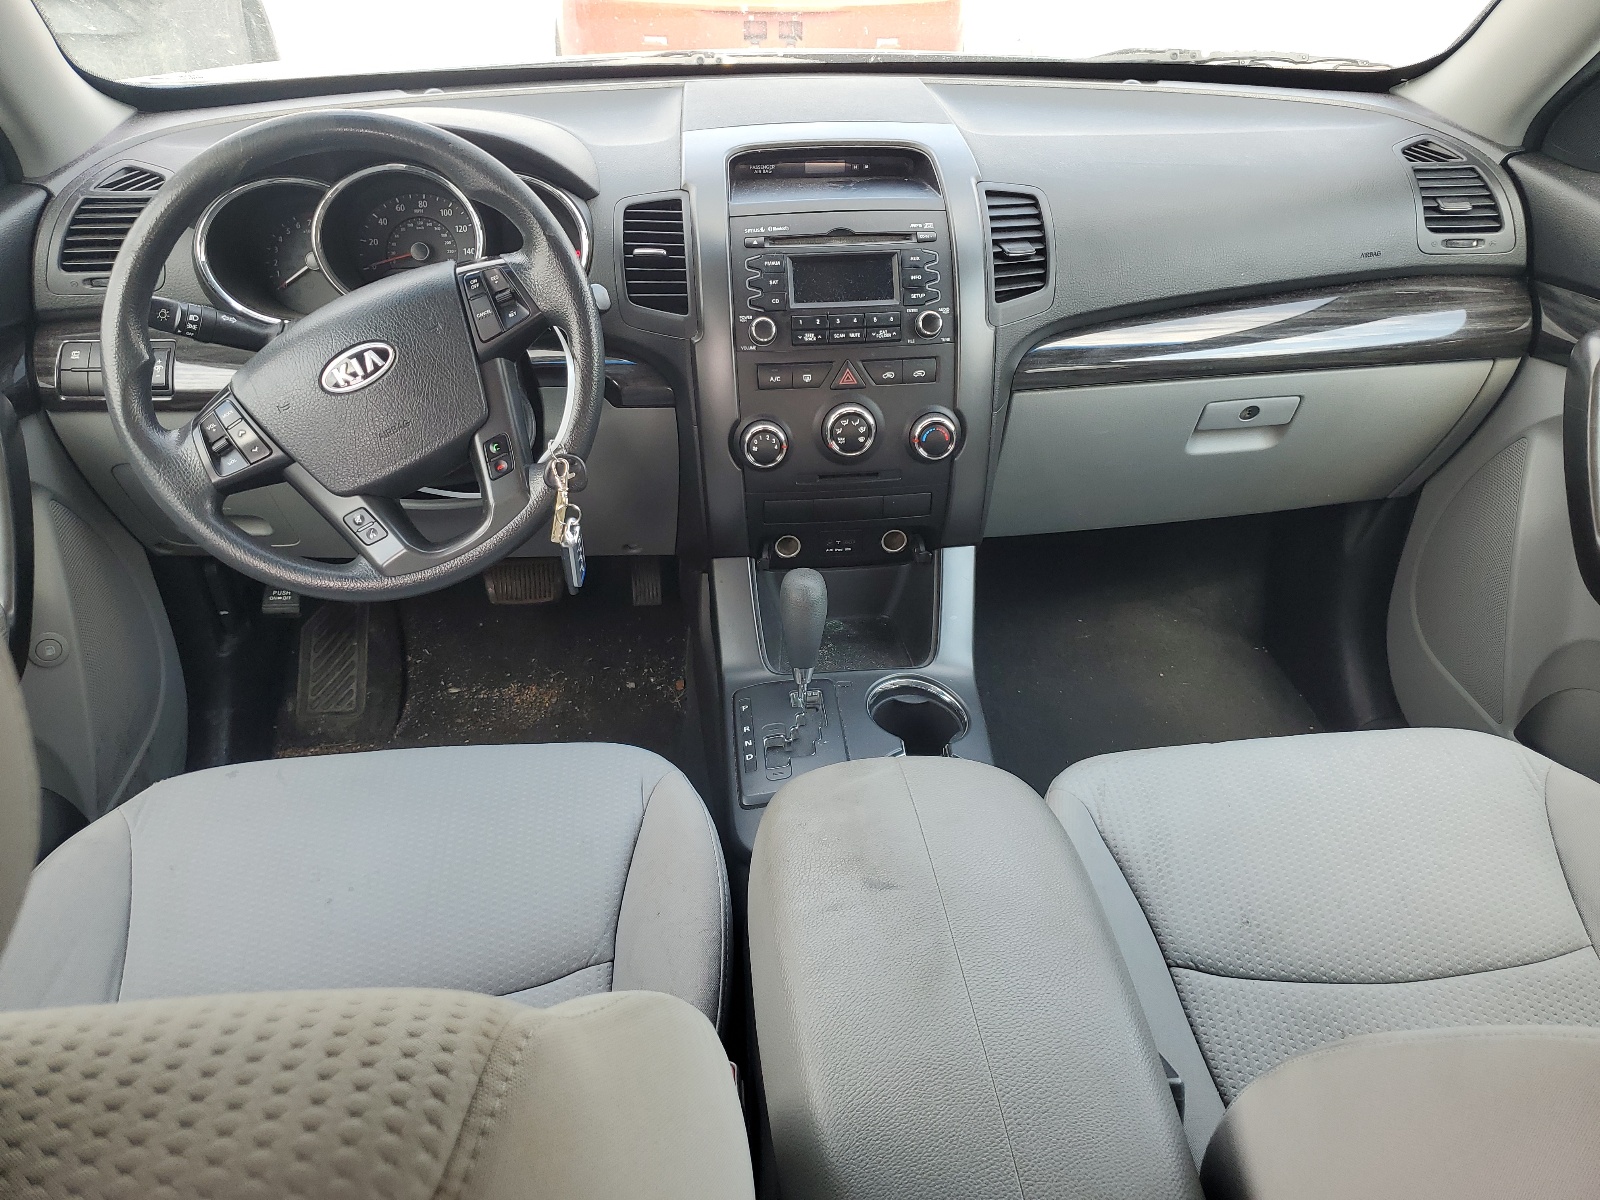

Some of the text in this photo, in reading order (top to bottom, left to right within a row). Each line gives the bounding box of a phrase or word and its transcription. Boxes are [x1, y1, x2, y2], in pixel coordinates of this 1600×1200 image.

[395, 204, 405, 212] 60
[440, 208, 453, 217] 100
[378, 218, 388, 226] 40
[455, 224, 468, 233] 120
[470, 282, 480, 290] OFF
[743, 725, 751, 733] R
[744, 739, 752, 747] N
